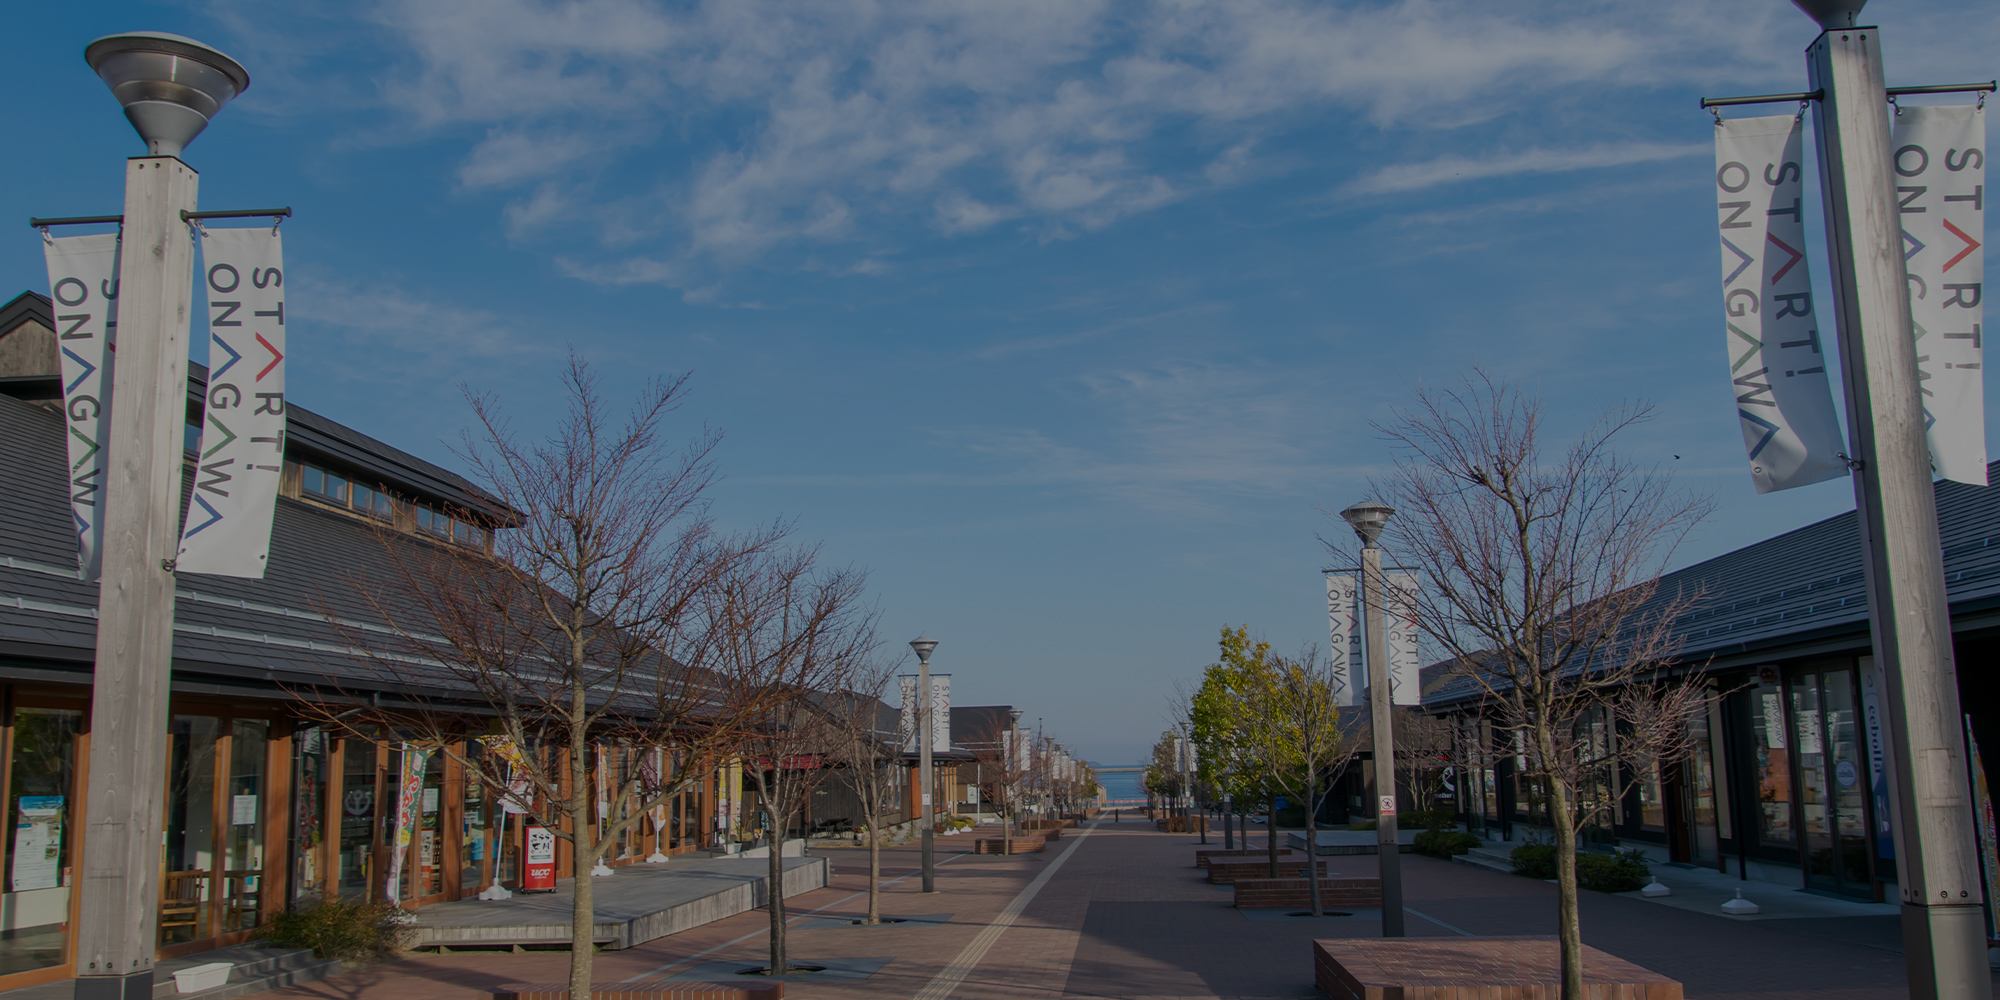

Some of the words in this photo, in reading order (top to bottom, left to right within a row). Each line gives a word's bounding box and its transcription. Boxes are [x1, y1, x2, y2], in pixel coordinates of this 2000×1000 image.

[1716, 160, 1780, 461] ONAGAWA
[1763, 161, 1825, 378] START!
[1942, 147, 1984, 371] START!
[54, 276, 102, 554] ONAGAWA
[184, 263, 242, 539] ONAGAWA
[246, 266, 285, 473] START!
[1327, 589, 1347, 694] ONAGAWA
[1344, 590, 1363, 667] START!
[1387, 586, 1402, 691] ONAGAWA
[1405, 588, 1419, 665] START!
[932, 684, 940, 744] ONAGAWA
[942, 685, 950, 729] START!
[1867, 705, 1883, 774] cebolla
[530, 868, 551, 876] UCC
